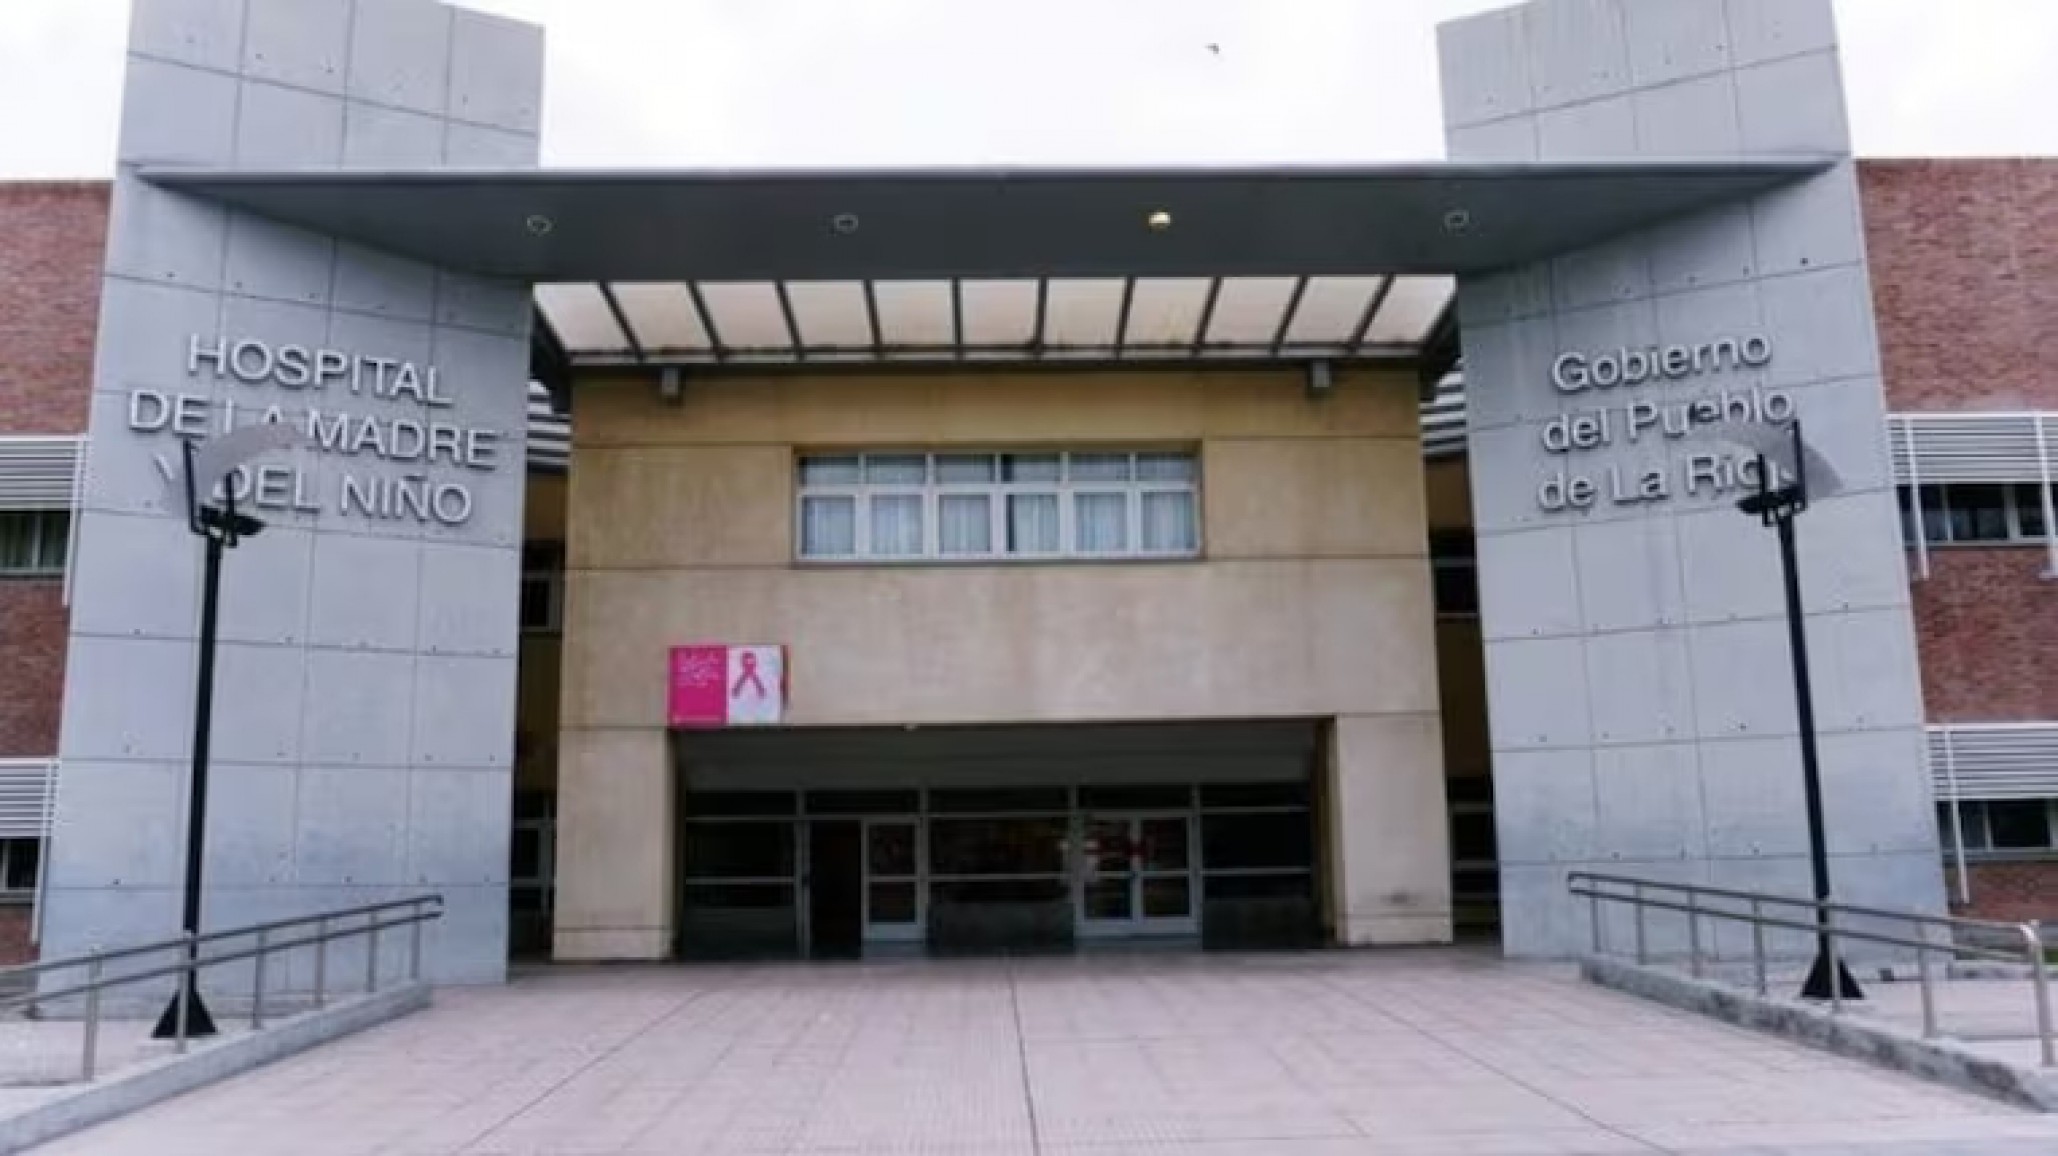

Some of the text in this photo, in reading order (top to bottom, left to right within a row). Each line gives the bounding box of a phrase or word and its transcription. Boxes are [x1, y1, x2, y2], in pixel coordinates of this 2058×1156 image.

[186, 333, 454, 408] HOSPITAL
[1552, 333, 1772, 393] Gobierno
[128, 388, 206, 437] DE
[307, 407, 502, 470] MADRE
[1543, 385, 1794, 453] del Pueblo
[212, 463, 322, 513] DEL
[340, 472, 474, 524] NIÑO
[1539, 450, 1796, 513] de La Rioj
